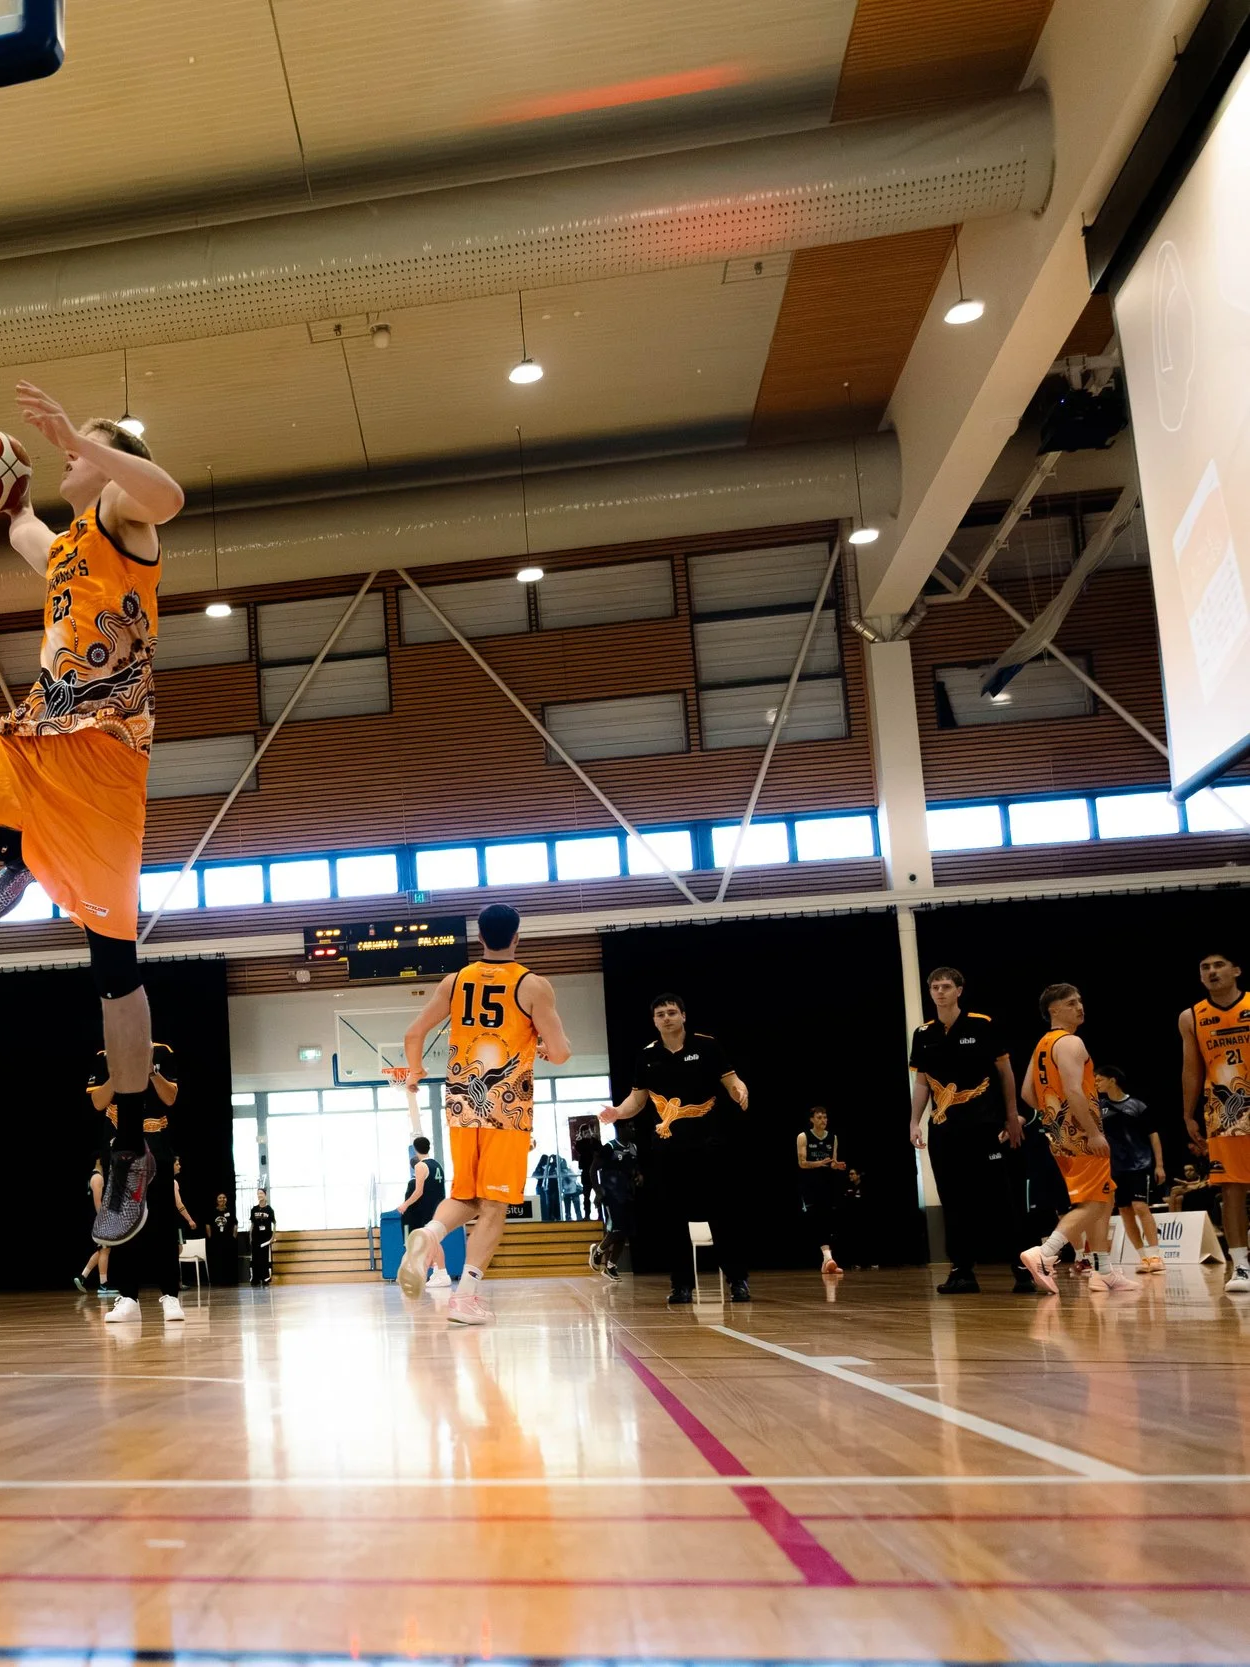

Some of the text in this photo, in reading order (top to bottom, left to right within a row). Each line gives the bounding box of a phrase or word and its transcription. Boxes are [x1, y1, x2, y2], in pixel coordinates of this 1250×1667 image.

[462, 982, 506, 1028] 15
[1038, 1051, 1048, 1085] 5
[1226, 1048, 1243, 1065] 21
[434, 1167, 443, 1184] 4
[1157, 1217, 1183, 1241] suto
